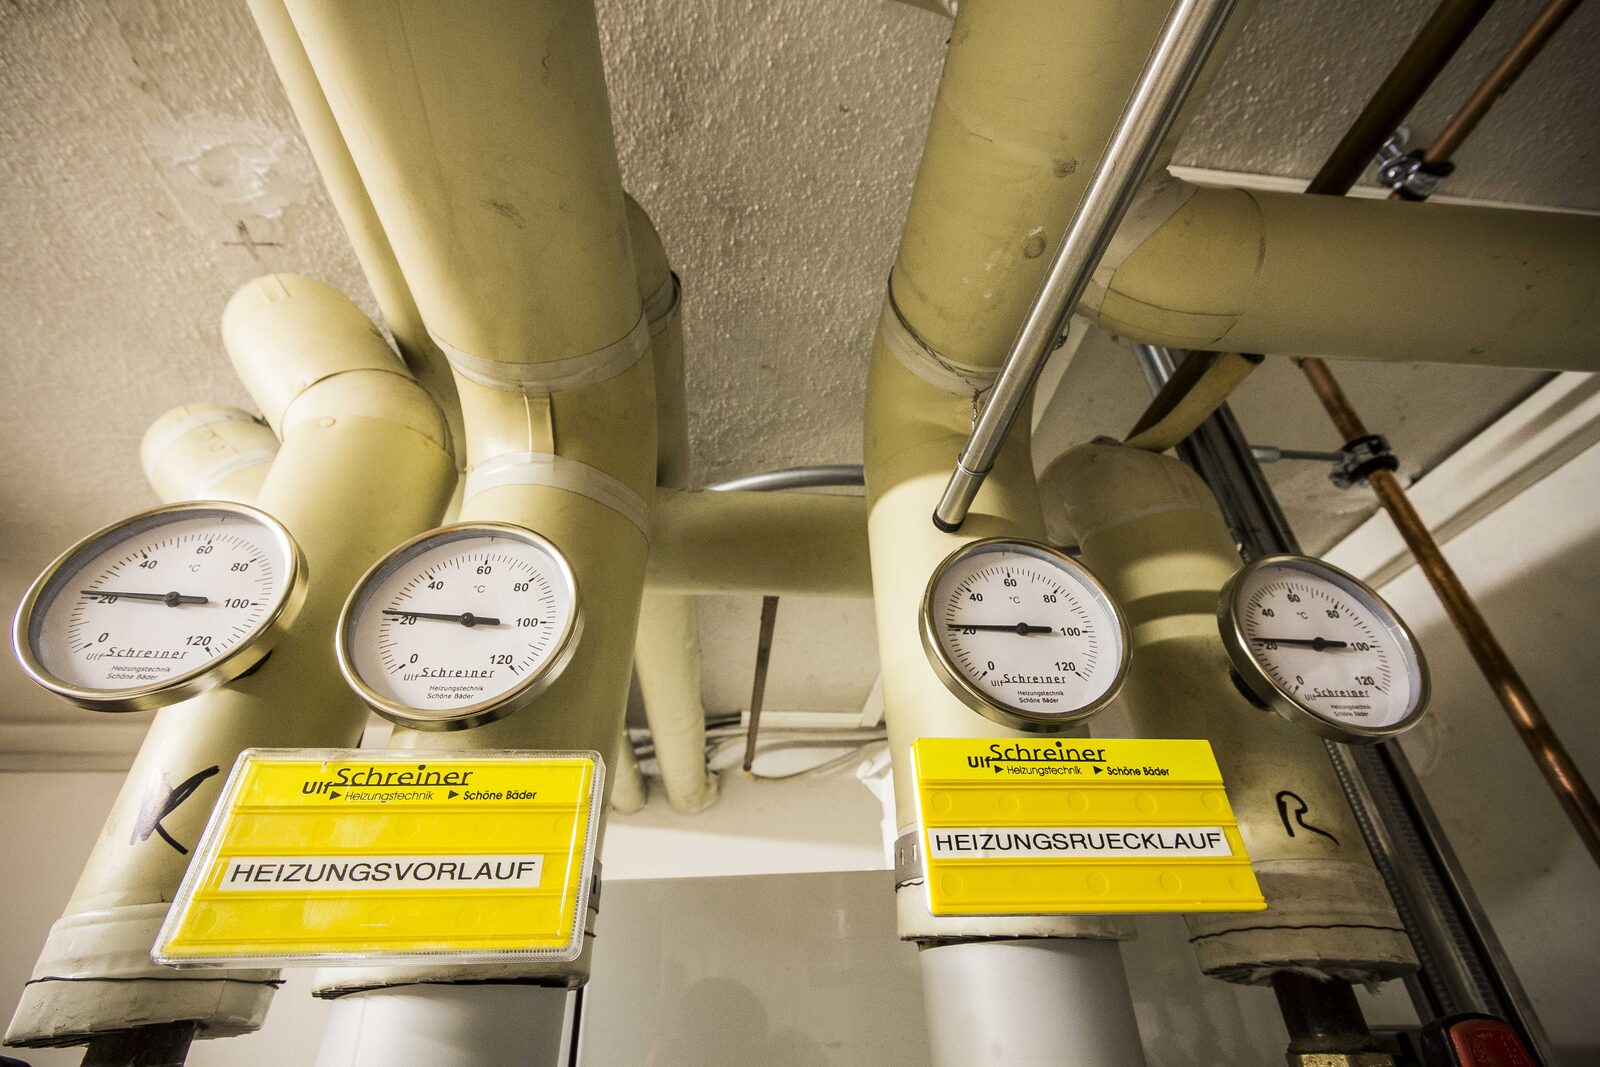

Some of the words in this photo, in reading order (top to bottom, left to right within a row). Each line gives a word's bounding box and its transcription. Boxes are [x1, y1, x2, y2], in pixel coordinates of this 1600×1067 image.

[196, 546, 212, 555] 60
[139, 560, 157, 570] 40
[231, 563, 248, 572] 80
[477, 566, 491, 575] 60
[428, 581, 443, 590] 40
[514, 583, 528, 592] 80
[1004, 579, 1017, 587] 60
[98, 594, 118, 604] 20
[970, 593, 983, 602] 40
[1043, 594, 1057, 603] 80
[1288, 594, 1300, 602] 60
[224, 599, 249, 609] 100
[1262, 609, 1274, 617] 40
[1326, 610, 1339, 618] 80
[400, 616, 417, 626] 20
[516, 618, 538, 627] 100
[962, 627, 976, 635] 20
[1060, 627, 1080, 636] 100
[98, 632, 108, 643] 0
[185, 635, 212, 646] 120
[1266, 642, 1277, 650] 20
[1351, 642, 1370, 651] 100
[106, 647, 188, 659] Schreiner
[410, 654, 418, 663] 0
[490, 655, 513, 664] 120
[987, 661, 995, 670] 0
[1055, 662, 1076, 671] 120
[106, 672, 134, 680] Schöne
[422, 667, 495, 678] Schreiner
[1004, 674, 1066, 683] Schreiner
[1296, 676, 1304, 685] 0
[1355, 676, 1374, 685] 120
[968, 756, 991, 768] Ulf
[990, 741, 1106, 762] Schreiner
[1007, 766, 1082, 776] Heizungstechnik
[1106, 766, 1141, 776] Schöne
[1143, 766, 1169, 776] Bäder
[302, 780, 332, 794] Ulf
[332, 765, 473, 786] Schreiner
[344, 790, 434, 802] Heizungstechnik
[463, 790, 503, 800] Schöne
[506, 790, 536, 800] Bäder
[1276, 790, 1340, 846] R
[935, 832, 1221, 851] HEIZUNGSRUECKLAUF
[231, 860, 535, 883] HEIZUNGSVORLAUF
